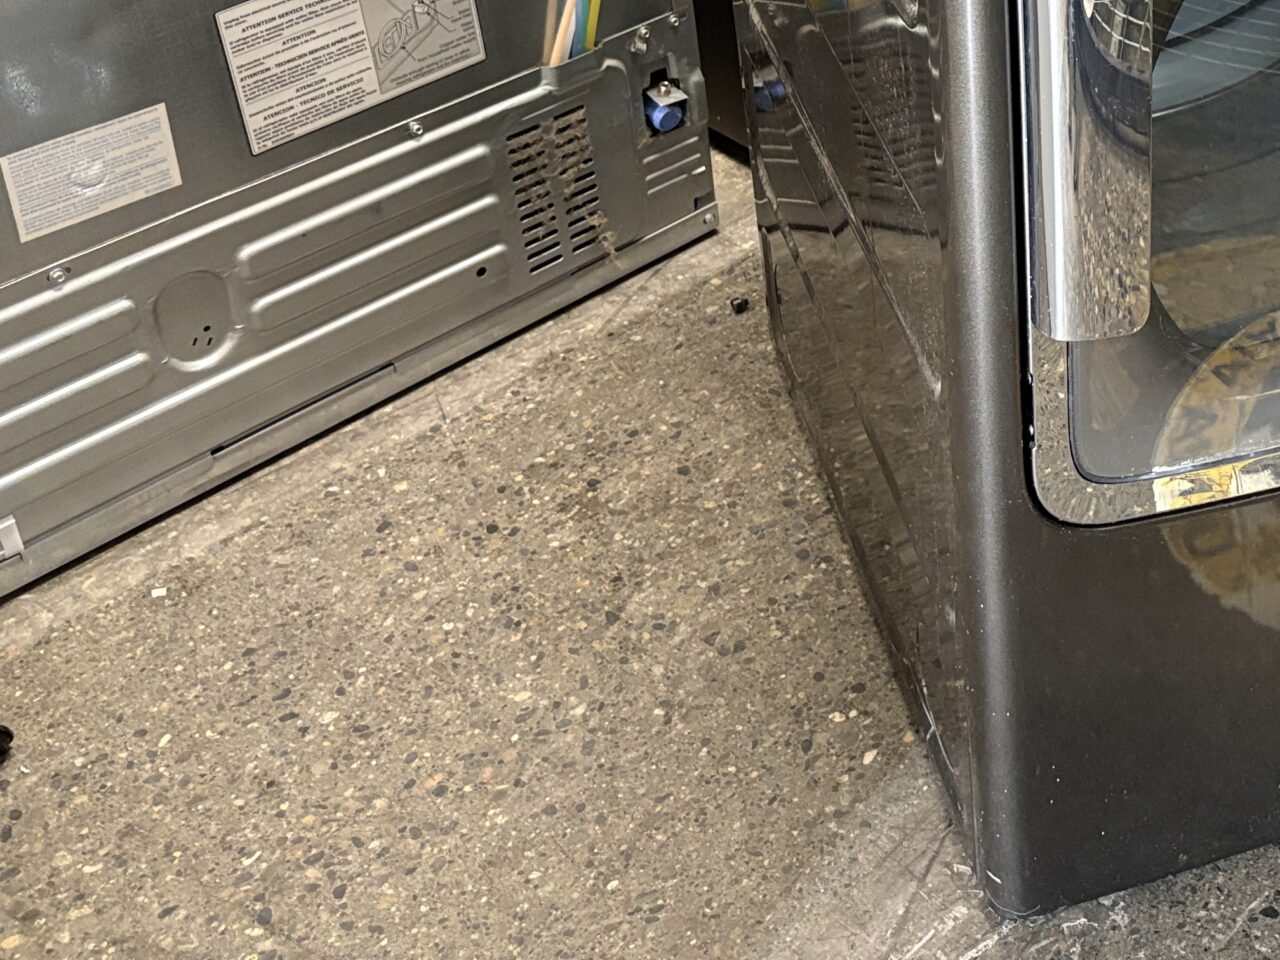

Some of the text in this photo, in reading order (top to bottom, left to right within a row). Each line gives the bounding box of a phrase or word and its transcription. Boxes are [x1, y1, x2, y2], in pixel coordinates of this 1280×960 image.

[241, 16, 276, 32] ATTENTION
[278, 7, 303, 19] SERVICE
[282, 30, 316, 45] ATTENTION
[239, 67, 270, 82] ATTENTION
[275, 53, 307, 68] TECHNICIEN
[308, 44, 329, 55] SERVICE
[295, 78, 325, 92] ATENCION
[263, 105, 294, 120] ATENCION
[300, 92, 325, 106] TECNICO
[336, 77, 363, 91] SERVICIO
